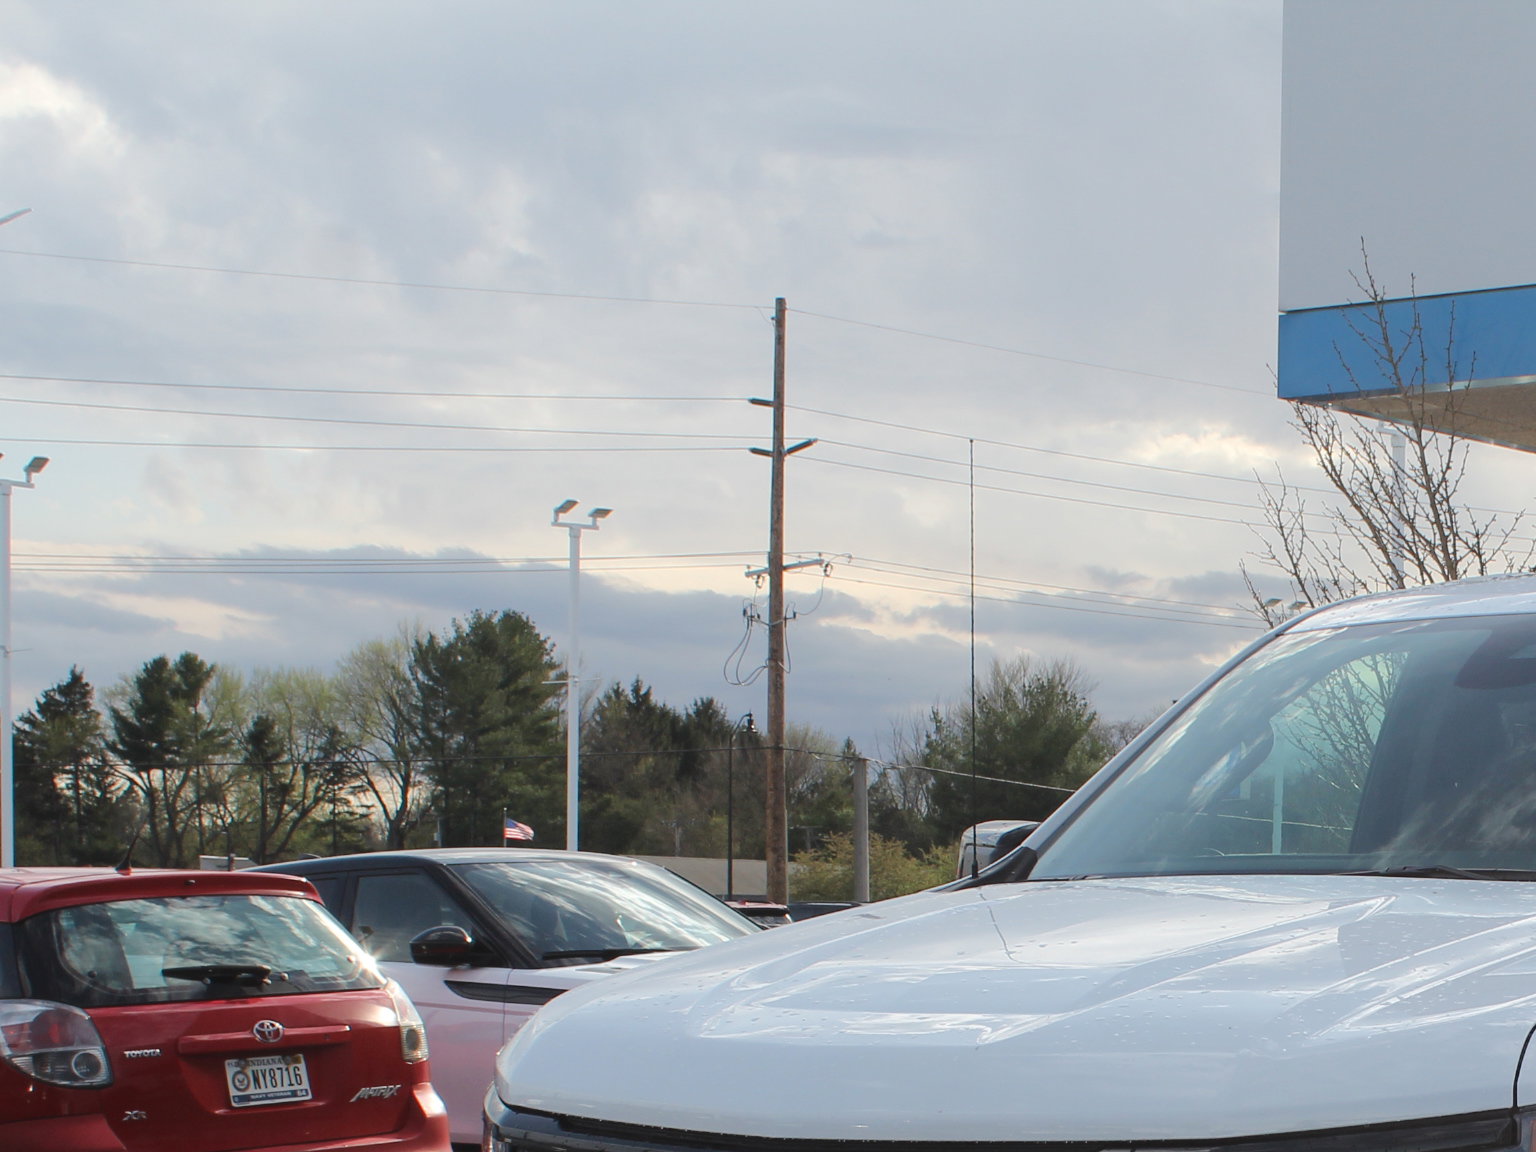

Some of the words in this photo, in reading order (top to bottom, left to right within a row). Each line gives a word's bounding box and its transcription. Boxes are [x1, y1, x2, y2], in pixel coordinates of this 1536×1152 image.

[123, 1048, 161, 1058] TOYOTA
[251, 1065, 303, 1090] NY8716
[349, 1084, 402, 1102] MATRIX
